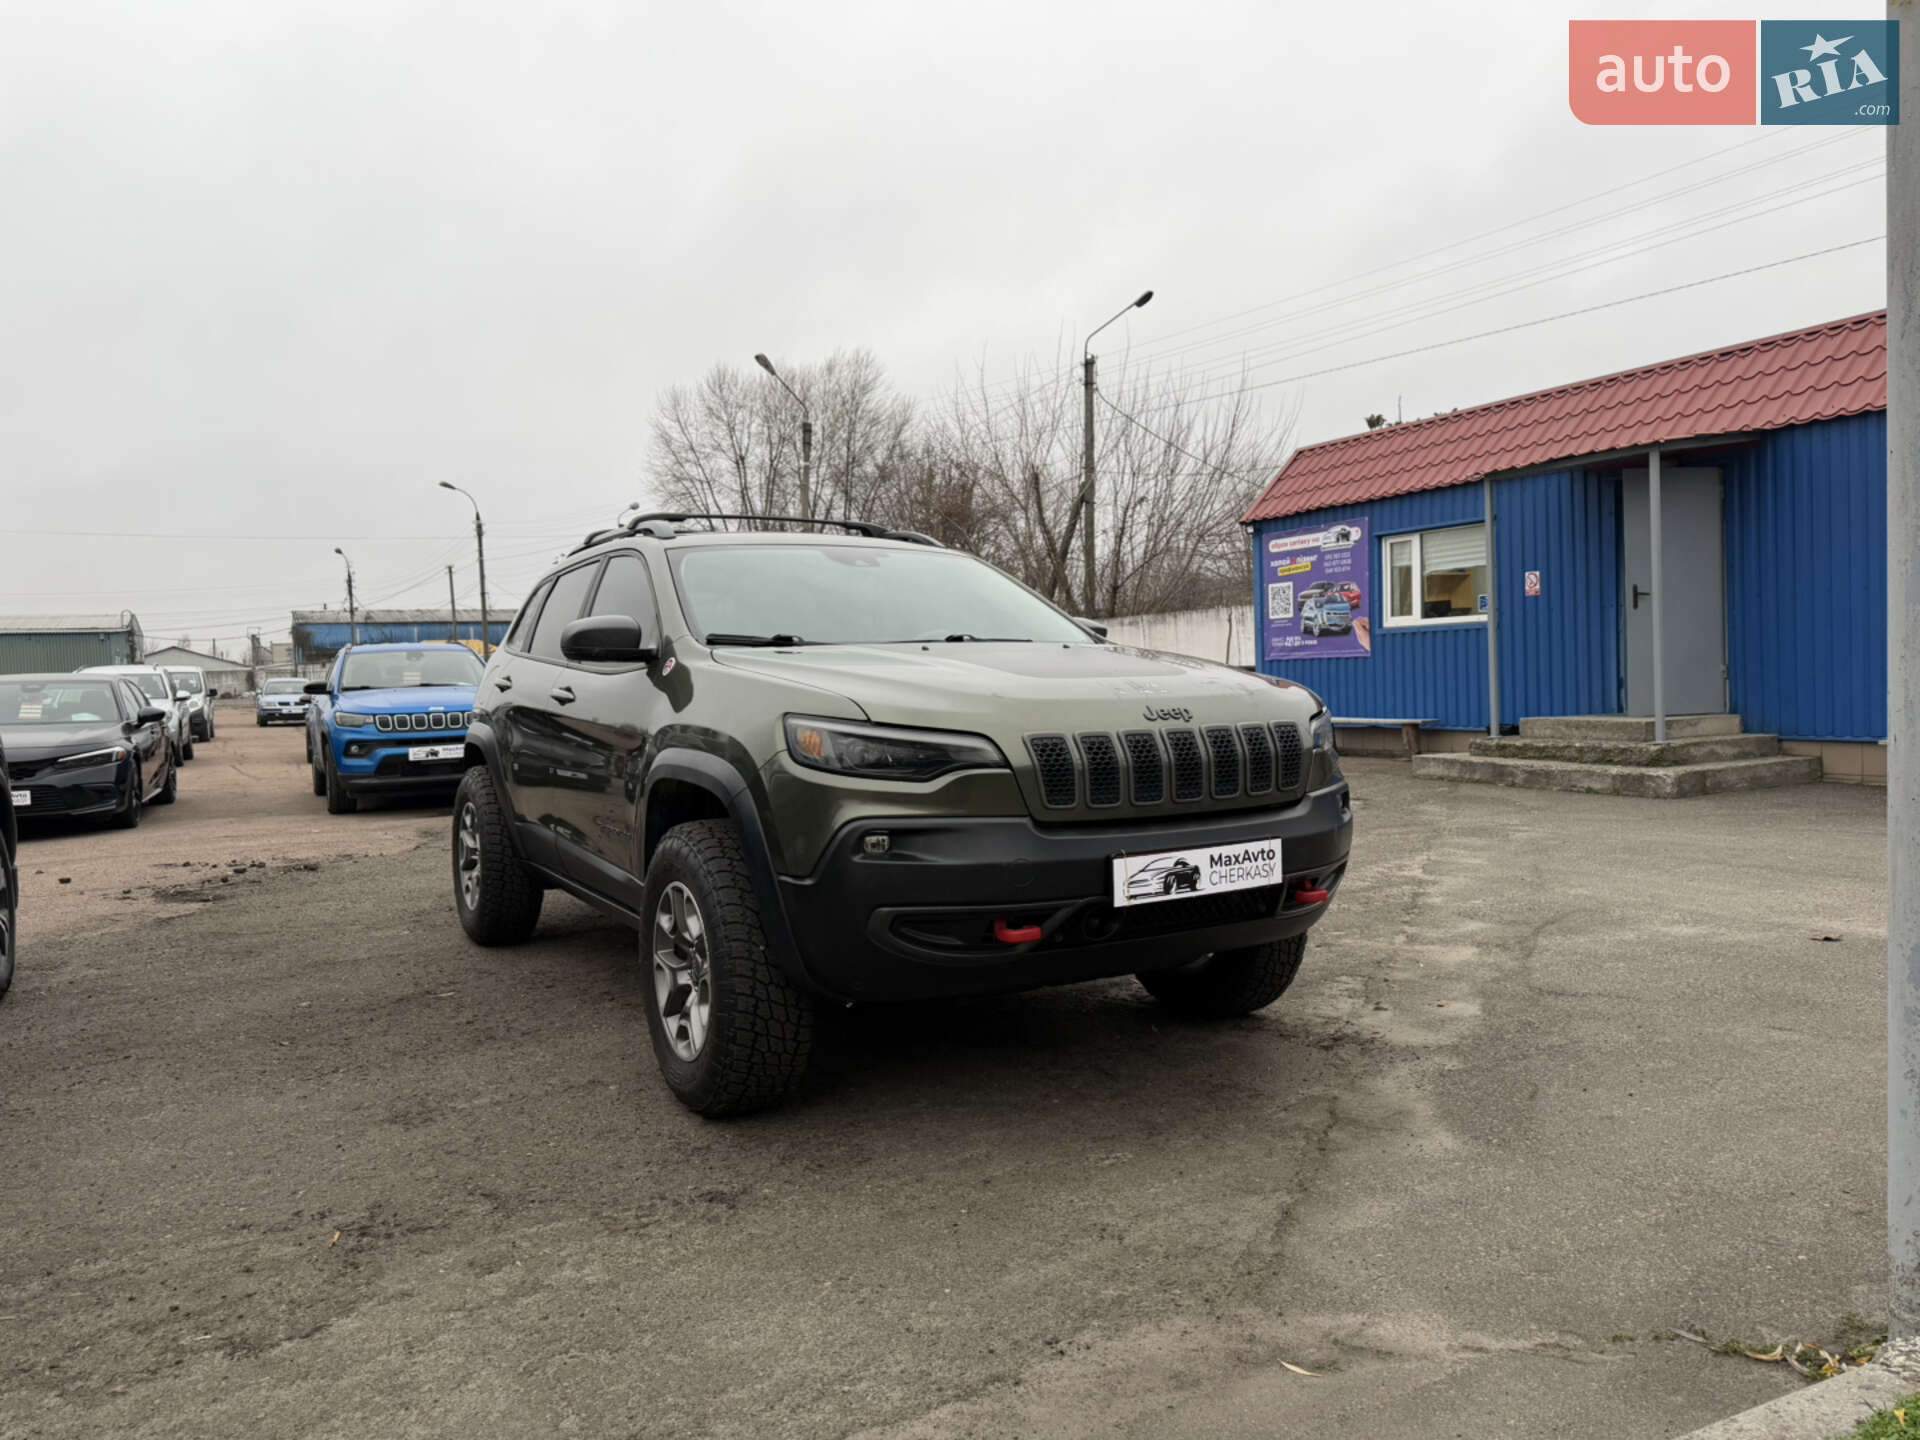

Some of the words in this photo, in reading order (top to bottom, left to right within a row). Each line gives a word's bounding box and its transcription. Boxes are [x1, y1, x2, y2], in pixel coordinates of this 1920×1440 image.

[1143, 705, 1193, 723] Jeep
[1209, 849, 1276, 868] MaxAvto
[1209, 863, 1276, 886] CHERKASY
